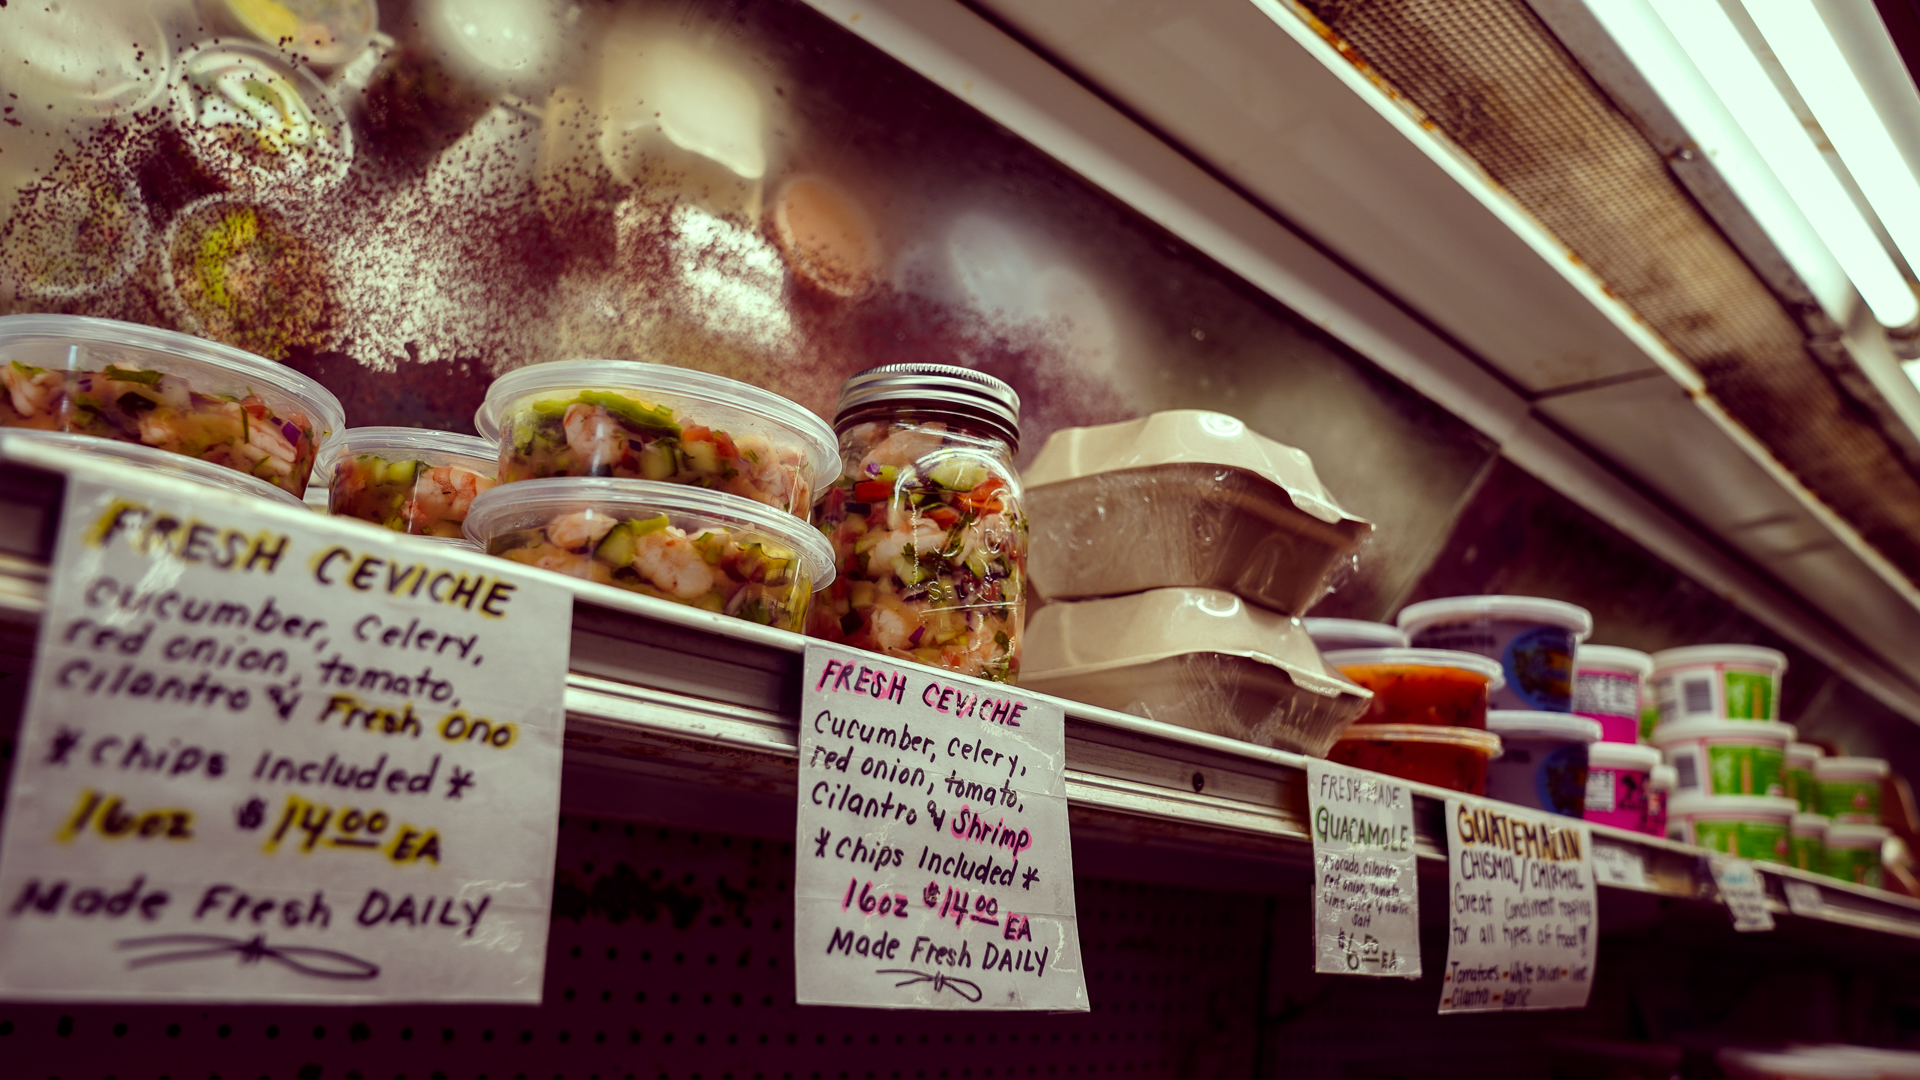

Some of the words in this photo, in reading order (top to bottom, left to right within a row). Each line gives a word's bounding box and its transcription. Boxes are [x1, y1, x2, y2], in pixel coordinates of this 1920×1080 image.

[96, 502, 290, 573] FRESH
[315, 548, 517, 618] CEVICHE
[63, 617, 155, 656] red
[165, 632, 300, 685] onion,
[320, 653, 462, 708] tomato,
[320, 693, 422, 739] Fresh
[820, 661, 906, 705] FRESH
[922, 682, 1027, 727] CEVICHE
[810, 745, 854, 773] red
[861, 755, 935, 795] onion,
[945, 770, 1024, 812] tomato,
[1320, 774, 1360, 804] FRESH
[393, 829, 442, 863] EA
[953, 809, 1030, 855] Shrimp
[1317, 807, 1407, 852] GUACAMOLE
[9, 876, 169, 917] Made
[195, 884, 332, 929] Fresh
[357, 891, 491, 936] DAILY
[845, 878, 908, 918] 16oz
[1007, 916, 1031, 941] EA
[1455, 882, 1492, 916] Great
[826, 927, 899, 959] Made
[910, 937, 971, 969] Fresh
[983, 942, 1048, 977] DAILY
[1480, 923, 1494, 944] all
